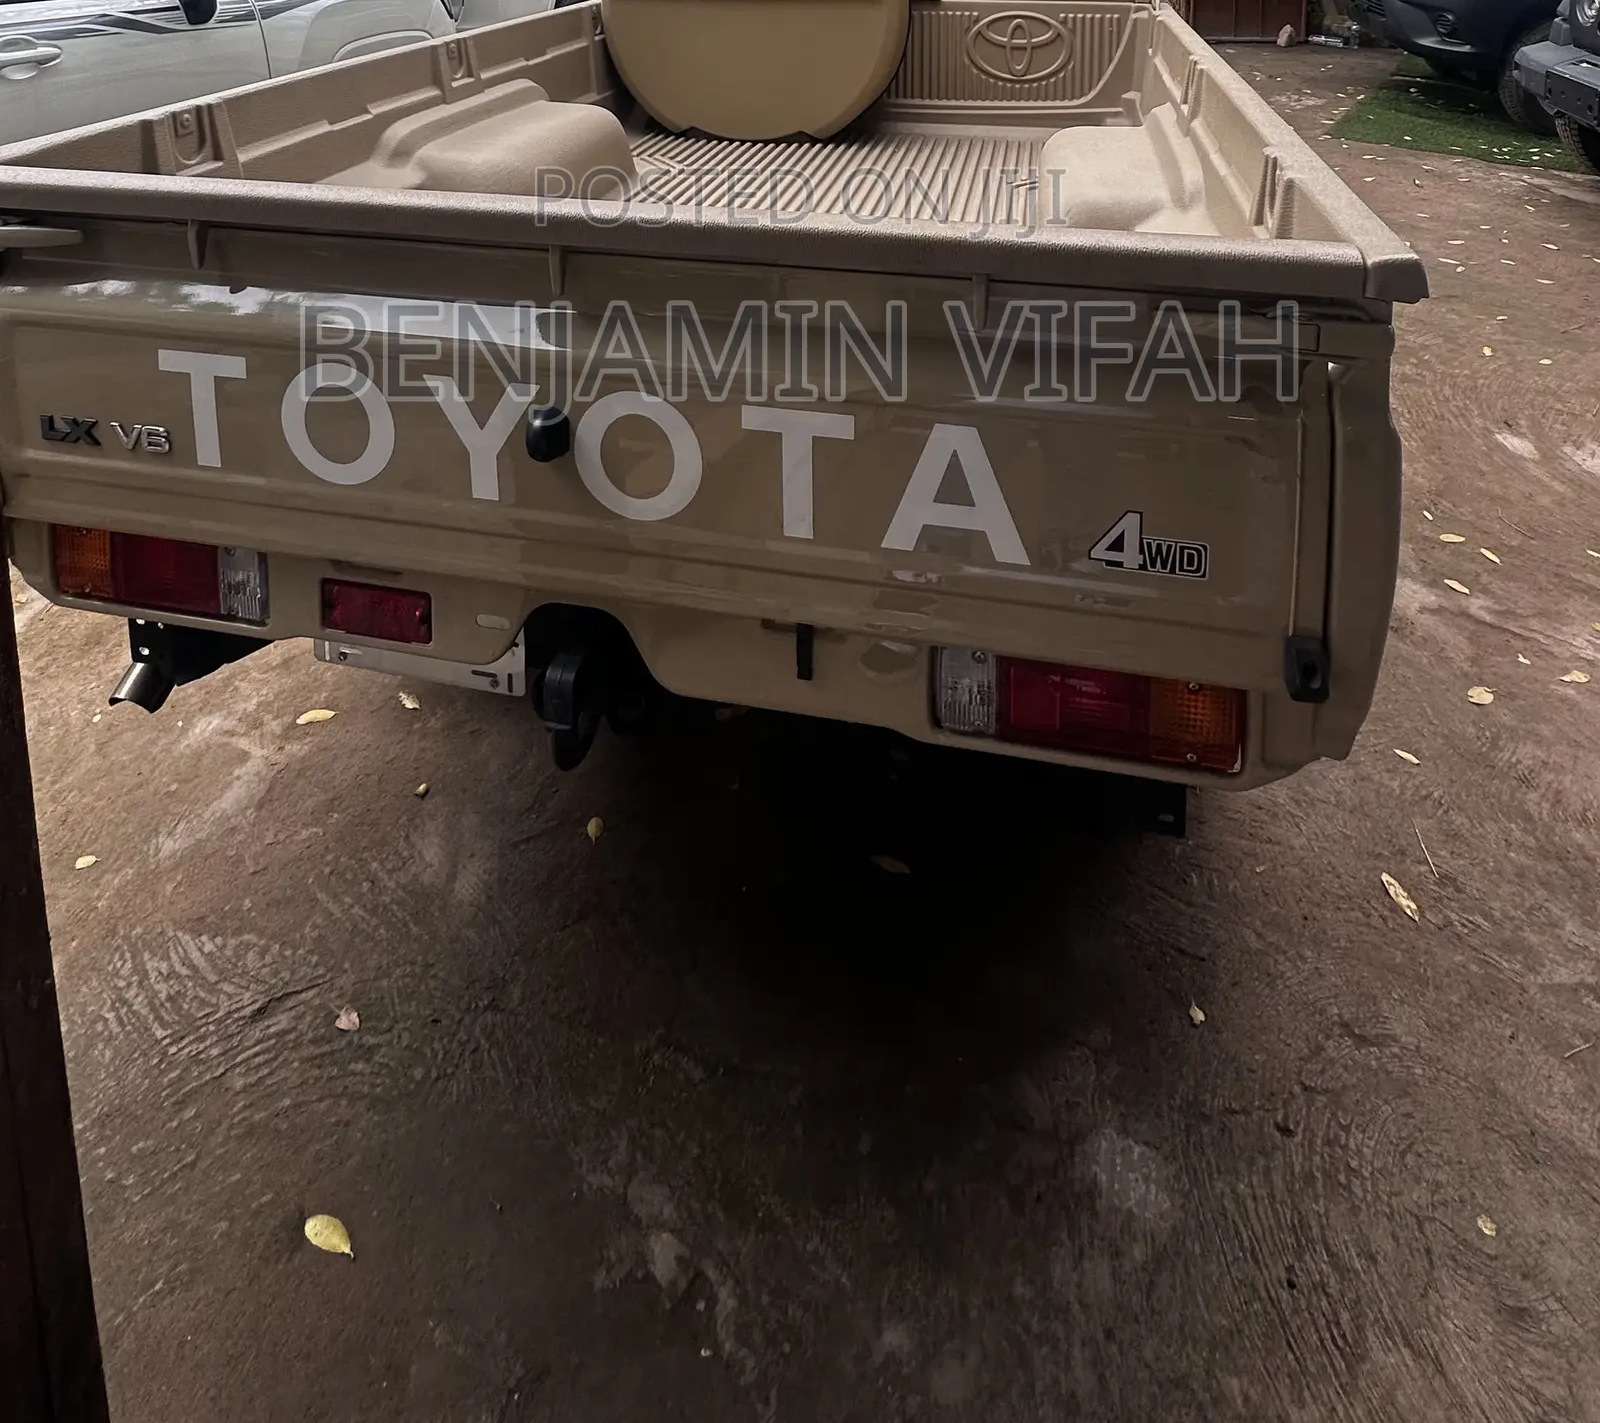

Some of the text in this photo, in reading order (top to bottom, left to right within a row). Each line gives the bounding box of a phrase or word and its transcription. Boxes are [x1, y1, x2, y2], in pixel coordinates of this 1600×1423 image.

[40, 414, 172, 454] LX V6
[157, 348, 1031, 567] TOYOTA
[1089, 510, 1208, 579] 4WD
